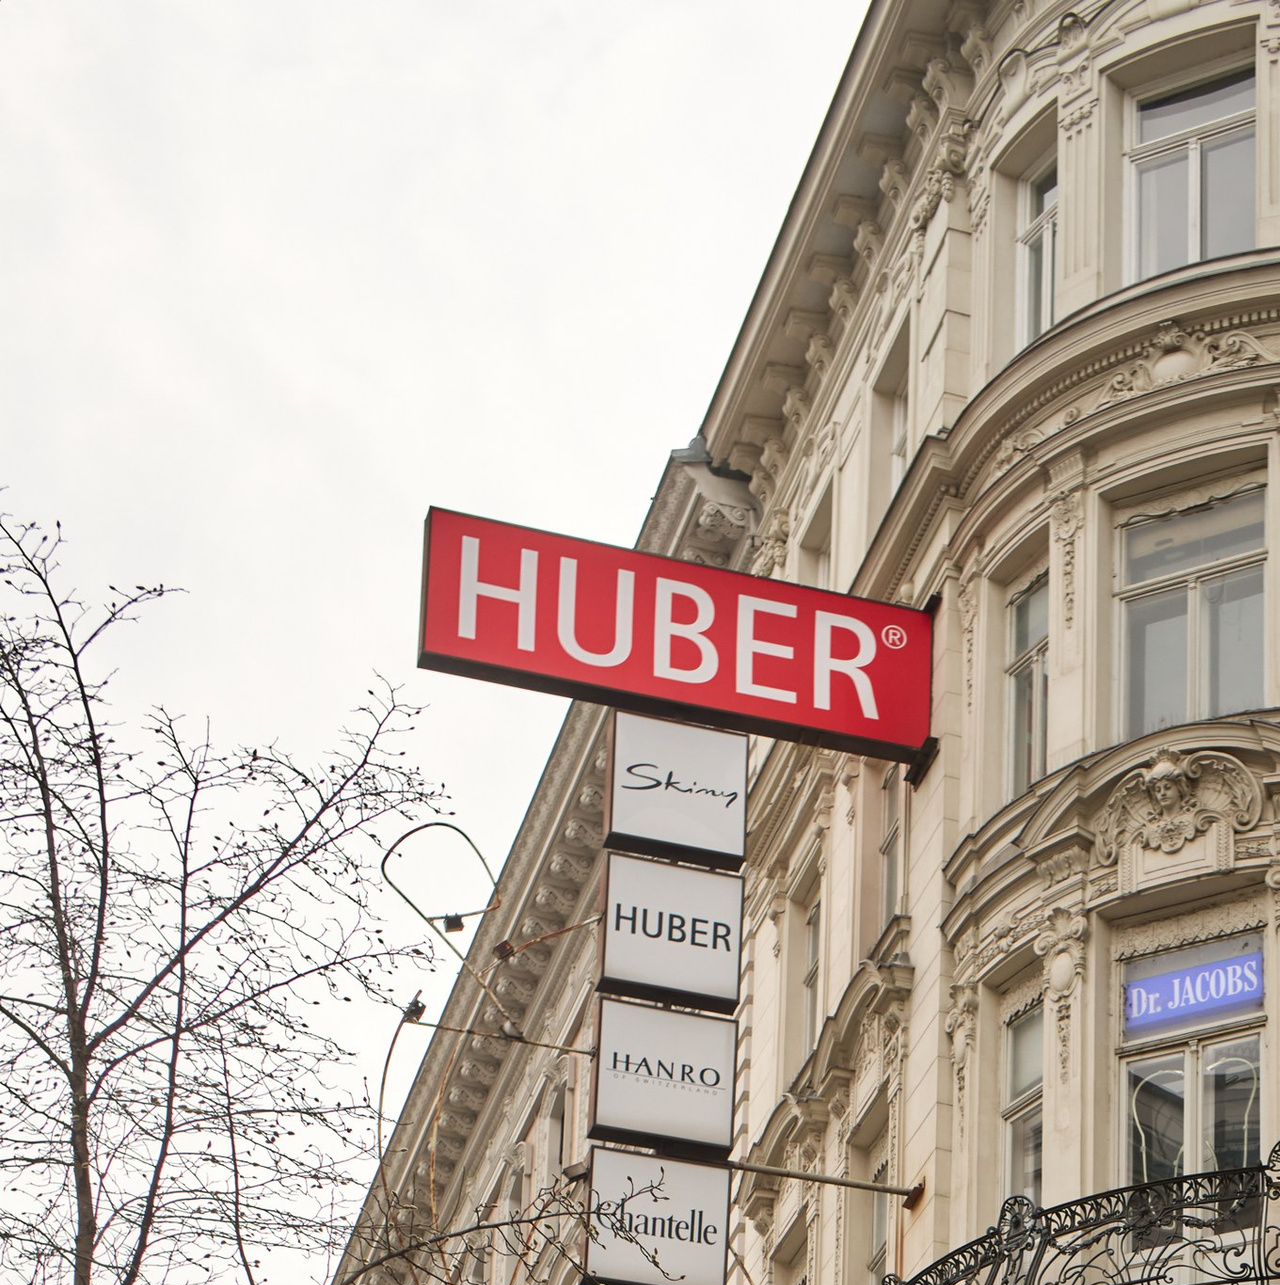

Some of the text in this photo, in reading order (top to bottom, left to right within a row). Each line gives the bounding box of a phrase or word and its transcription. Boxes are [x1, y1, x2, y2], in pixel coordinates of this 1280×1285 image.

[614, 902, 732, 952] HUBER
[1131, 960, 1258, 1018] Dr. JACOBS
[611, 1051, 721, 1087] HANRO
[635, 1077, 718, 1096] SWITZERLAND
[597, 1198, 718, 1246] Chantelle
